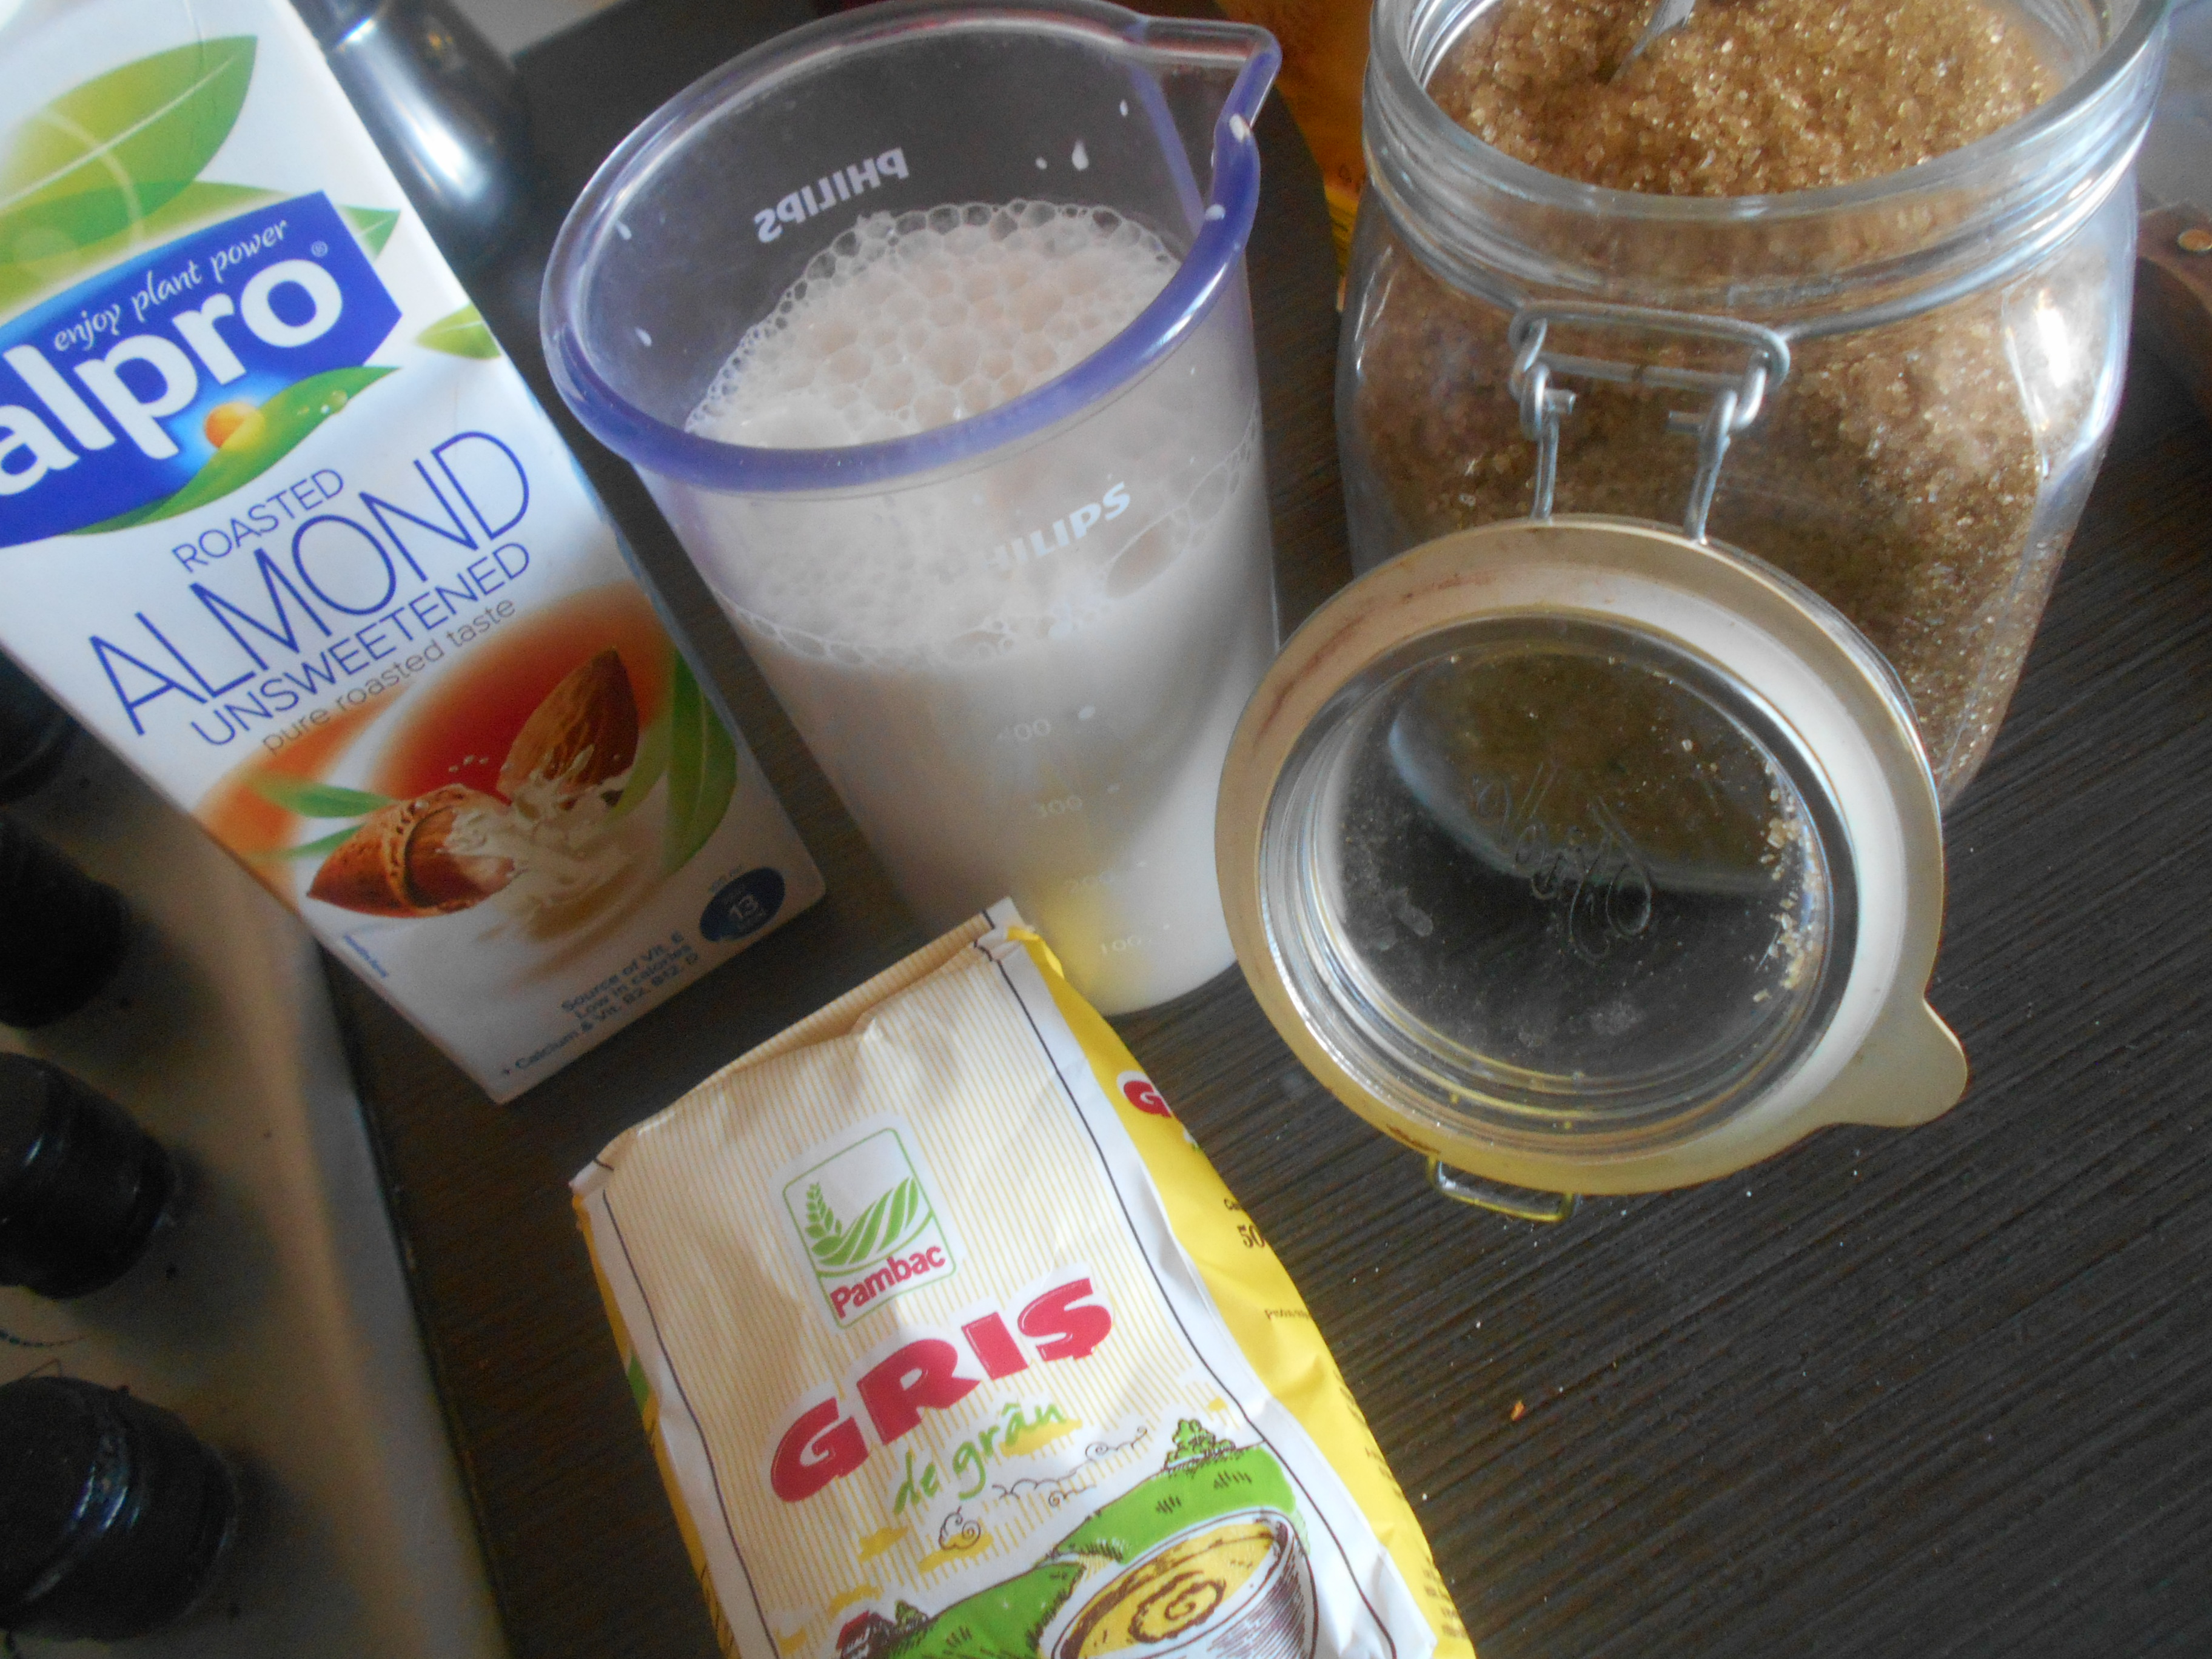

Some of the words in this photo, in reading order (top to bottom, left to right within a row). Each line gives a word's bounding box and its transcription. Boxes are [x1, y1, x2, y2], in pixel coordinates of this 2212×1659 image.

[53, 304, 122, 352] enjoy
[131, 261, 202, 321] plant
[210, 220, 289, 281] power
[0, 258, 343, 495] alpro
[89, 431, 530, 736] ALMOND
[172, 468, 344, 573] ROASTED
[982, 481, 1131, 571] HILIPS
[190, 542, 531, 746] UNSWEETENED
[263, 709, 330, 756] pure
[336, 639, 446, 707] roasted
[446, 597, 516, 650] taste
[829, 1245, 947, 1320] Pambac
[893, 1452, 939, 1515] de
